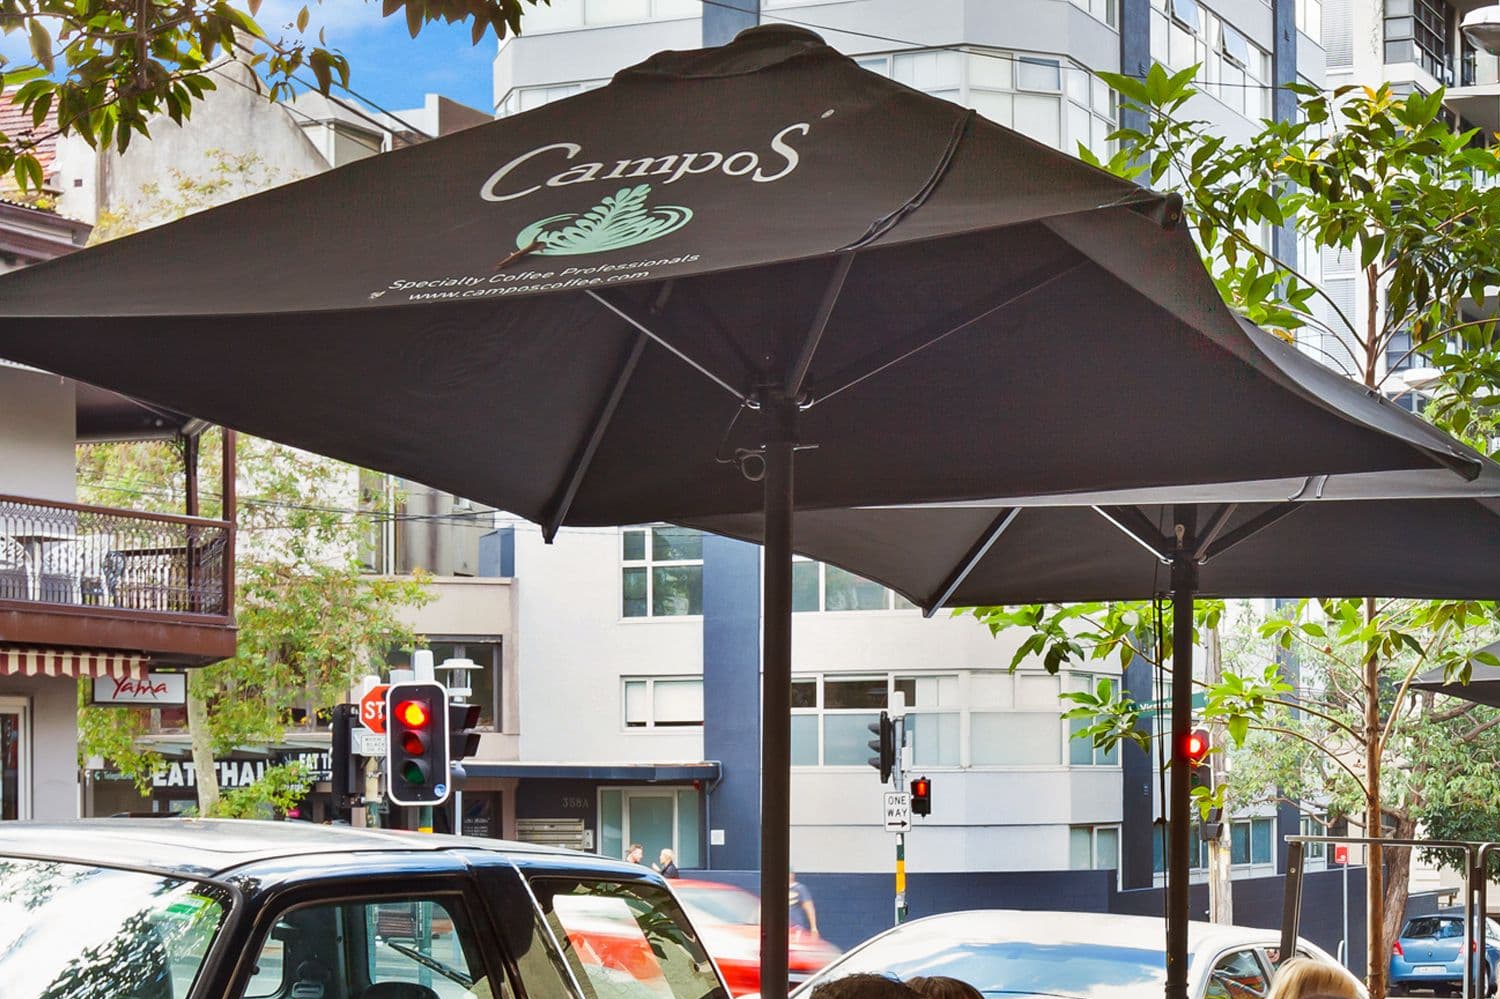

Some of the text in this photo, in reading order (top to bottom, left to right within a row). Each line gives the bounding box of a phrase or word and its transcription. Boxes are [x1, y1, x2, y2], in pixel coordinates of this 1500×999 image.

[388, 253, 701, 291] Specialty Coffee Professionals
[408, 270, 650, 301] www.camposcoffee.com
[152, 761, 197, 787] EAT
[887, 808, 908, 817] WAY
[888, 795, 907, 805] ONE
